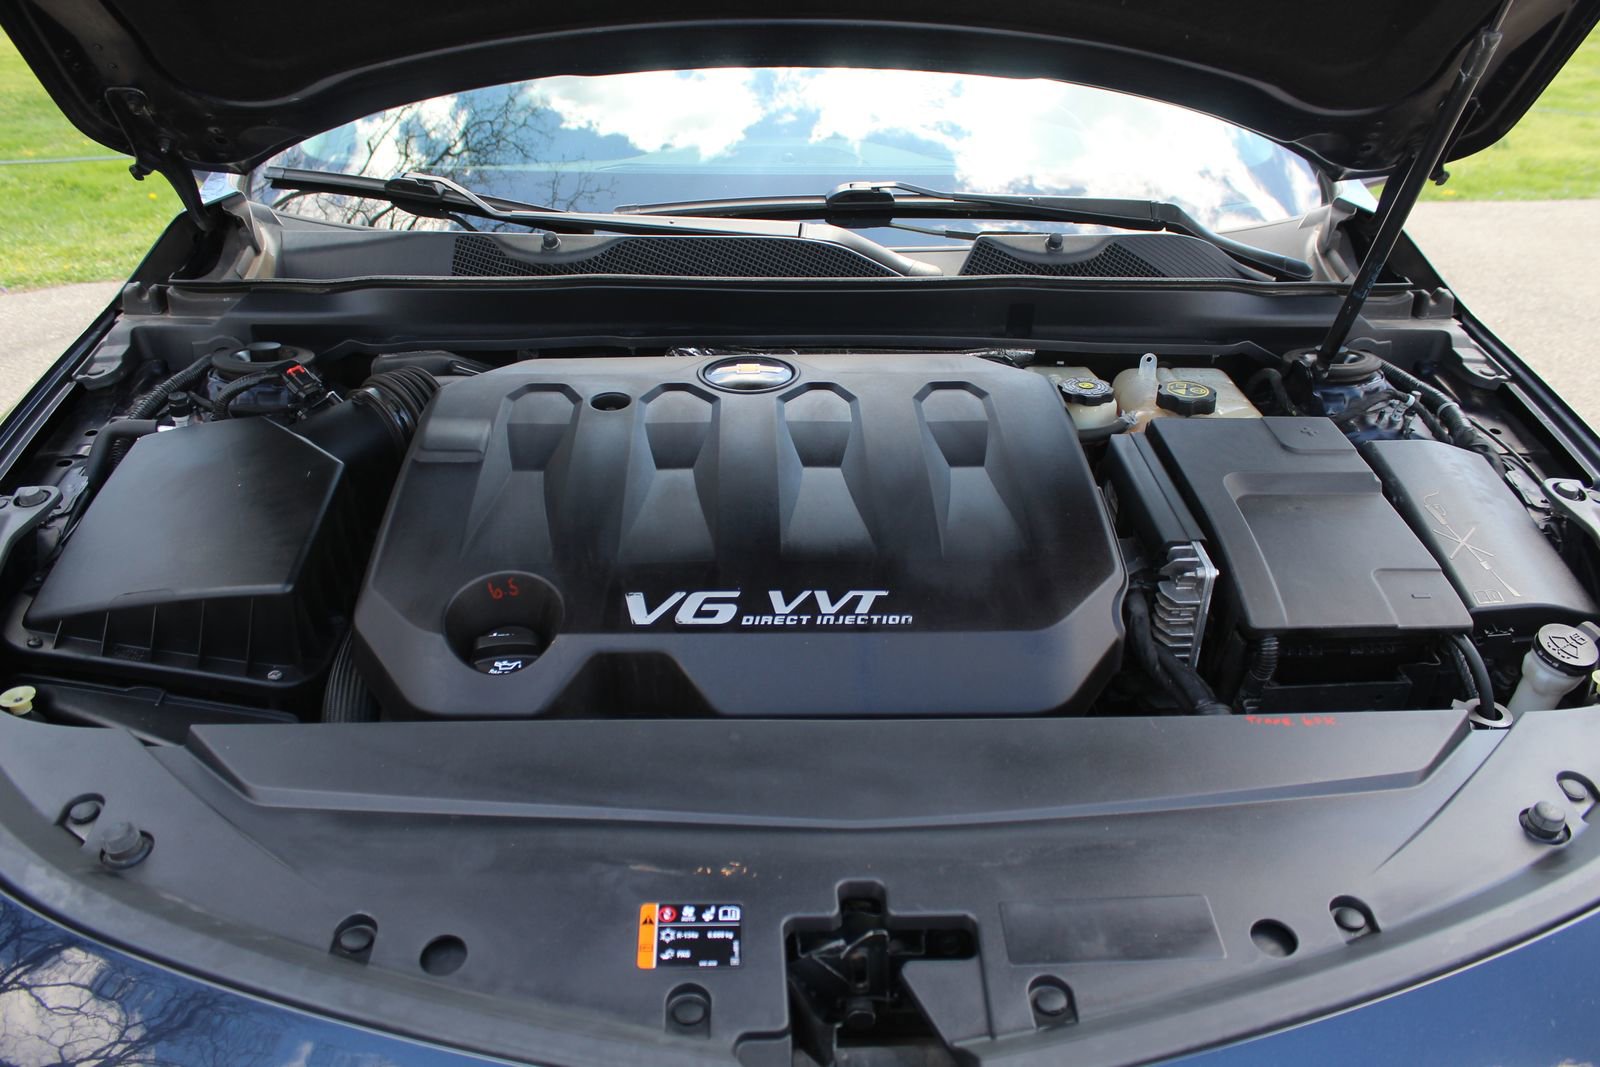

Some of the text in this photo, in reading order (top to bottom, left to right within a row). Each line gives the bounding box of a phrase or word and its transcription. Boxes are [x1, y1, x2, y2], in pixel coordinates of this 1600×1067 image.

[625, 589, 889, 625] V6 VVT
[741, 614, 913, 625] DIRECT INJECTION
